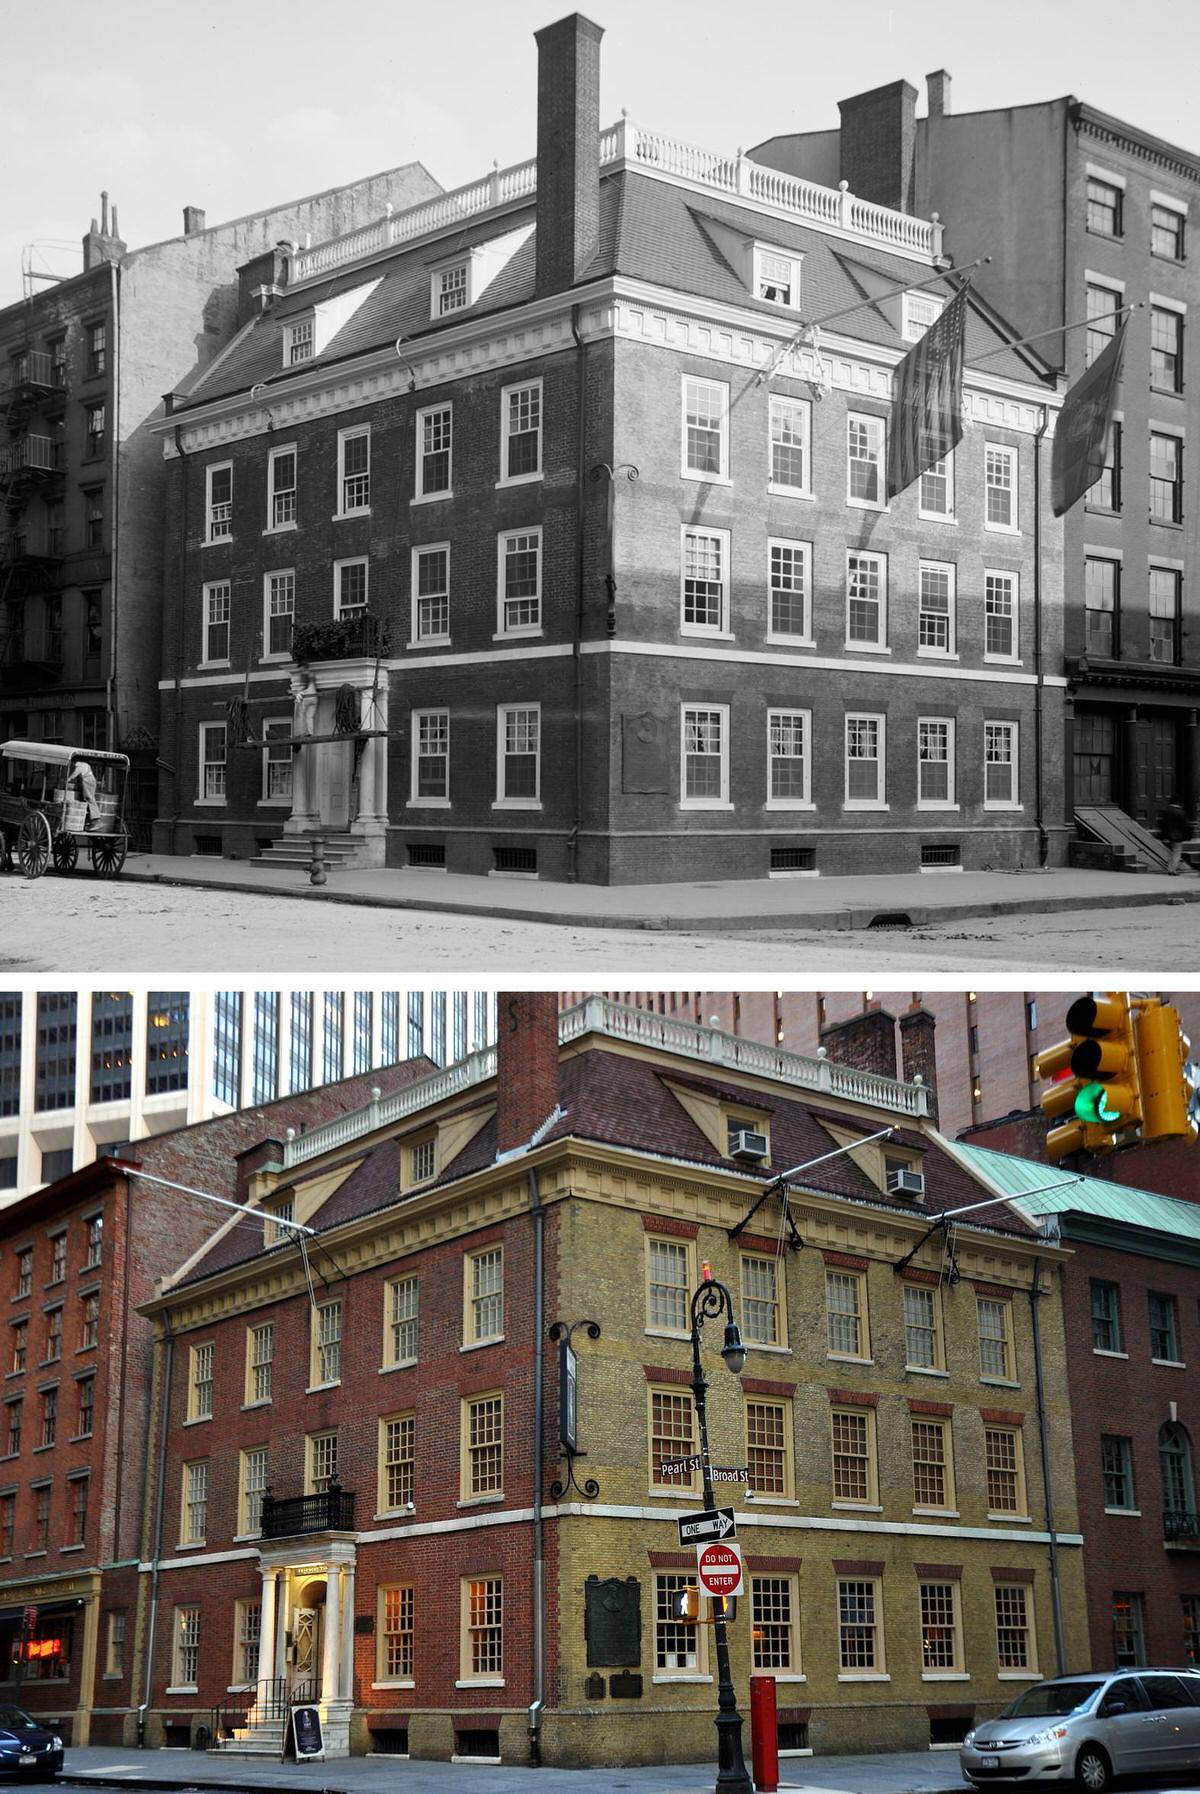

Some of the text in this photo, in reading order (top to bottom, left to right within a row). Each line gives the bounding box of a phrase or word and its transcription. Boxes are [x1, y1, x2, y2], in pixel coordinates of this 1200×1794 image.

[662, 1458, 699, 1477] Pearl St
[713, 1470, 749, 1482] Broad St
[686, 1518, 729, 1536] ONE WAY
[705, 1554, 732, 1563] DO NOT
[709, 1577, 733, 1586] ENTER
